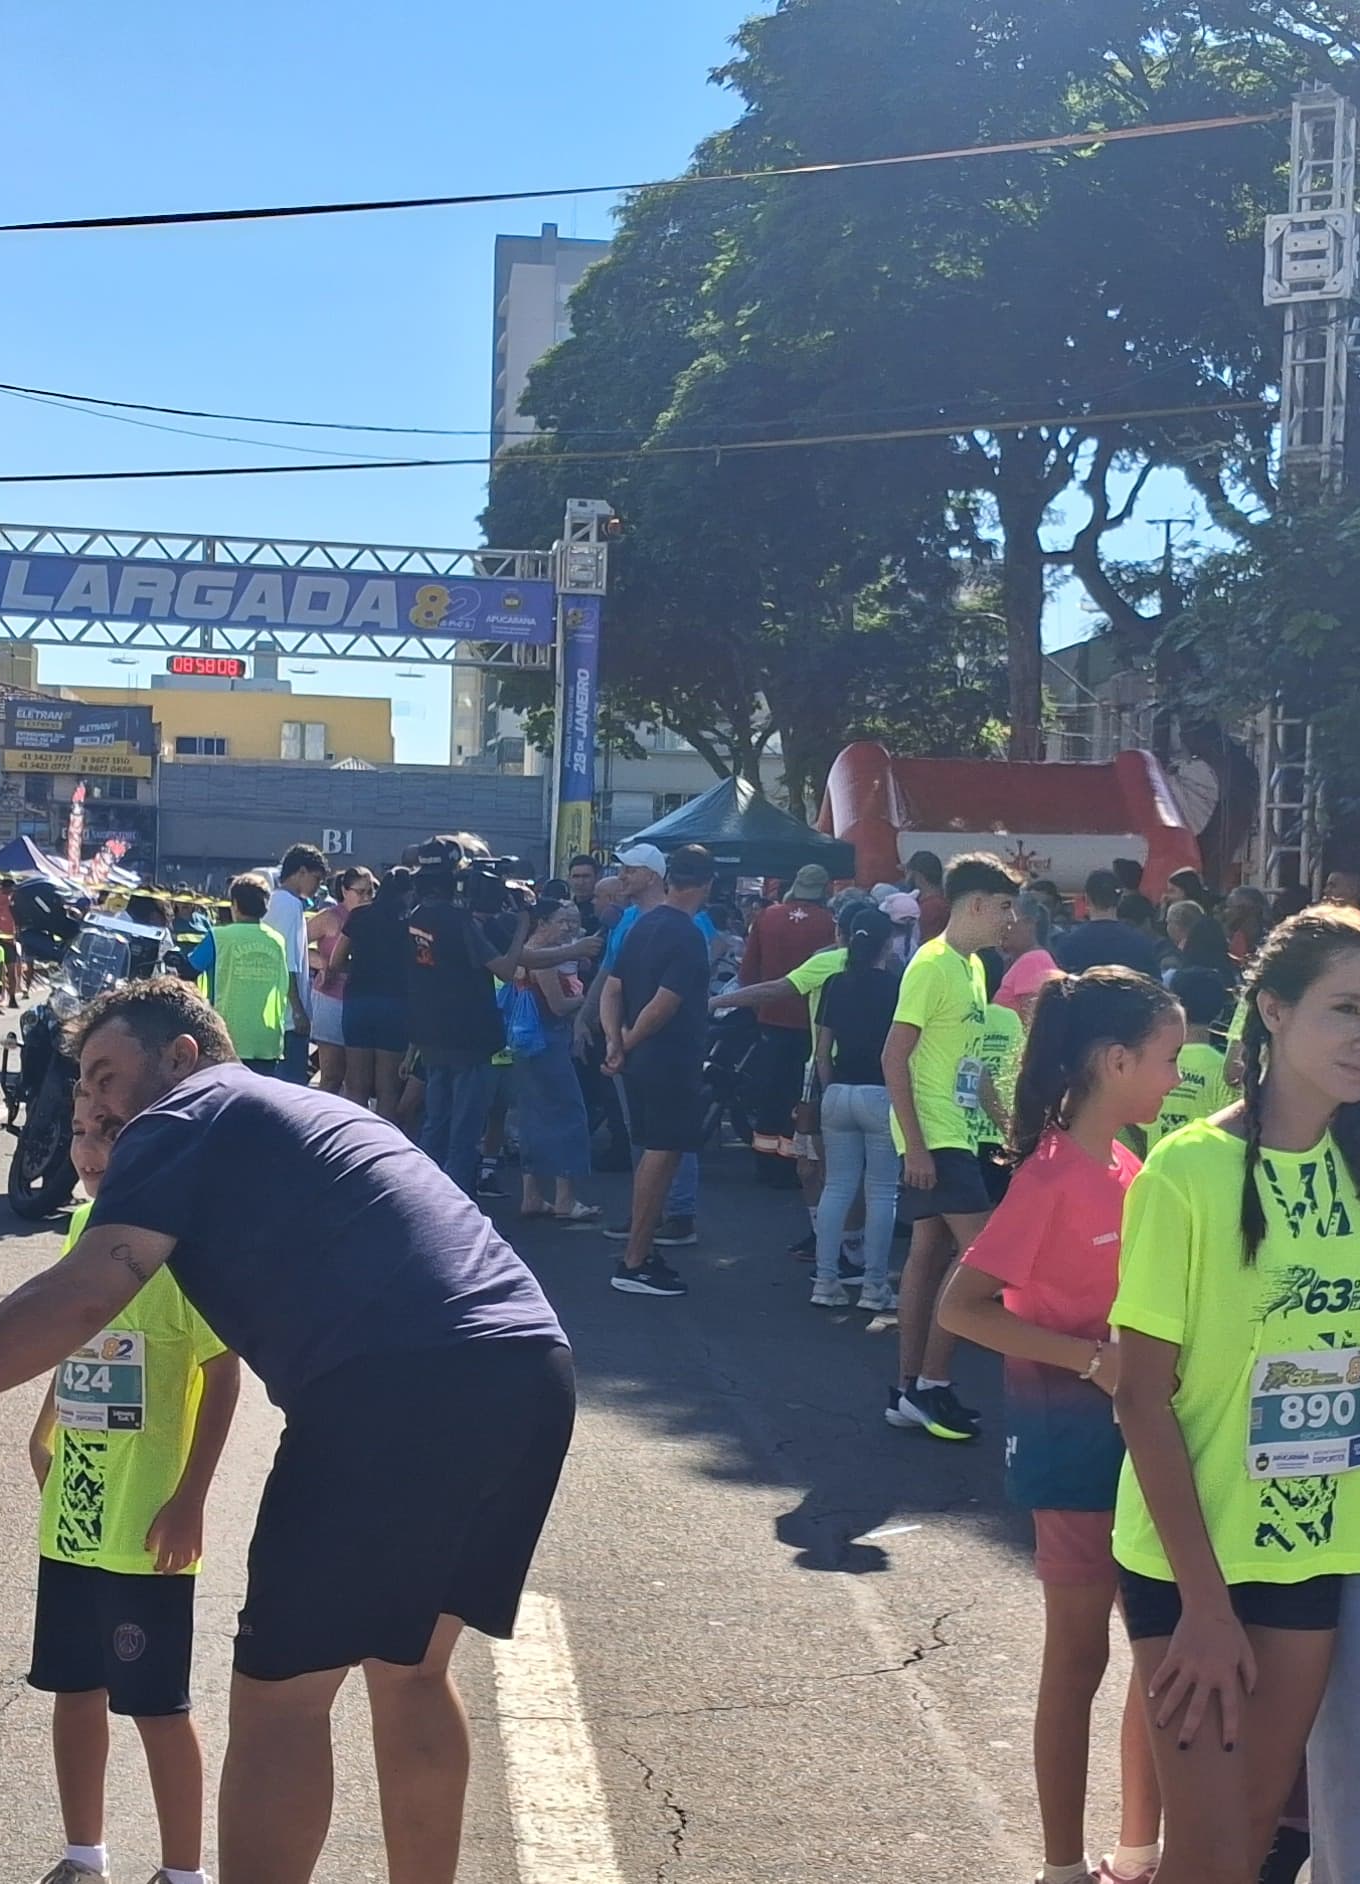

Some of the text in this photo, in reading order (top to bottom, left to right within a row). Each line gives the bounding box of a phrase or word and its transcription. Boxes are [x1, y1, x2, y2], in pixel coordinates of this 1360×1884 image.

[1, 559, 399, 629] LARGADA
[16, 708, 64, 721] ELETRAN
[574, 668, 590, 739] JANEIRO
[573, 752, 587, 775] 28
[322, 829, 353, 854] B1
[63, 1362, 113, 1393] 424
[1280, 1391, 1356, 1429] 890
